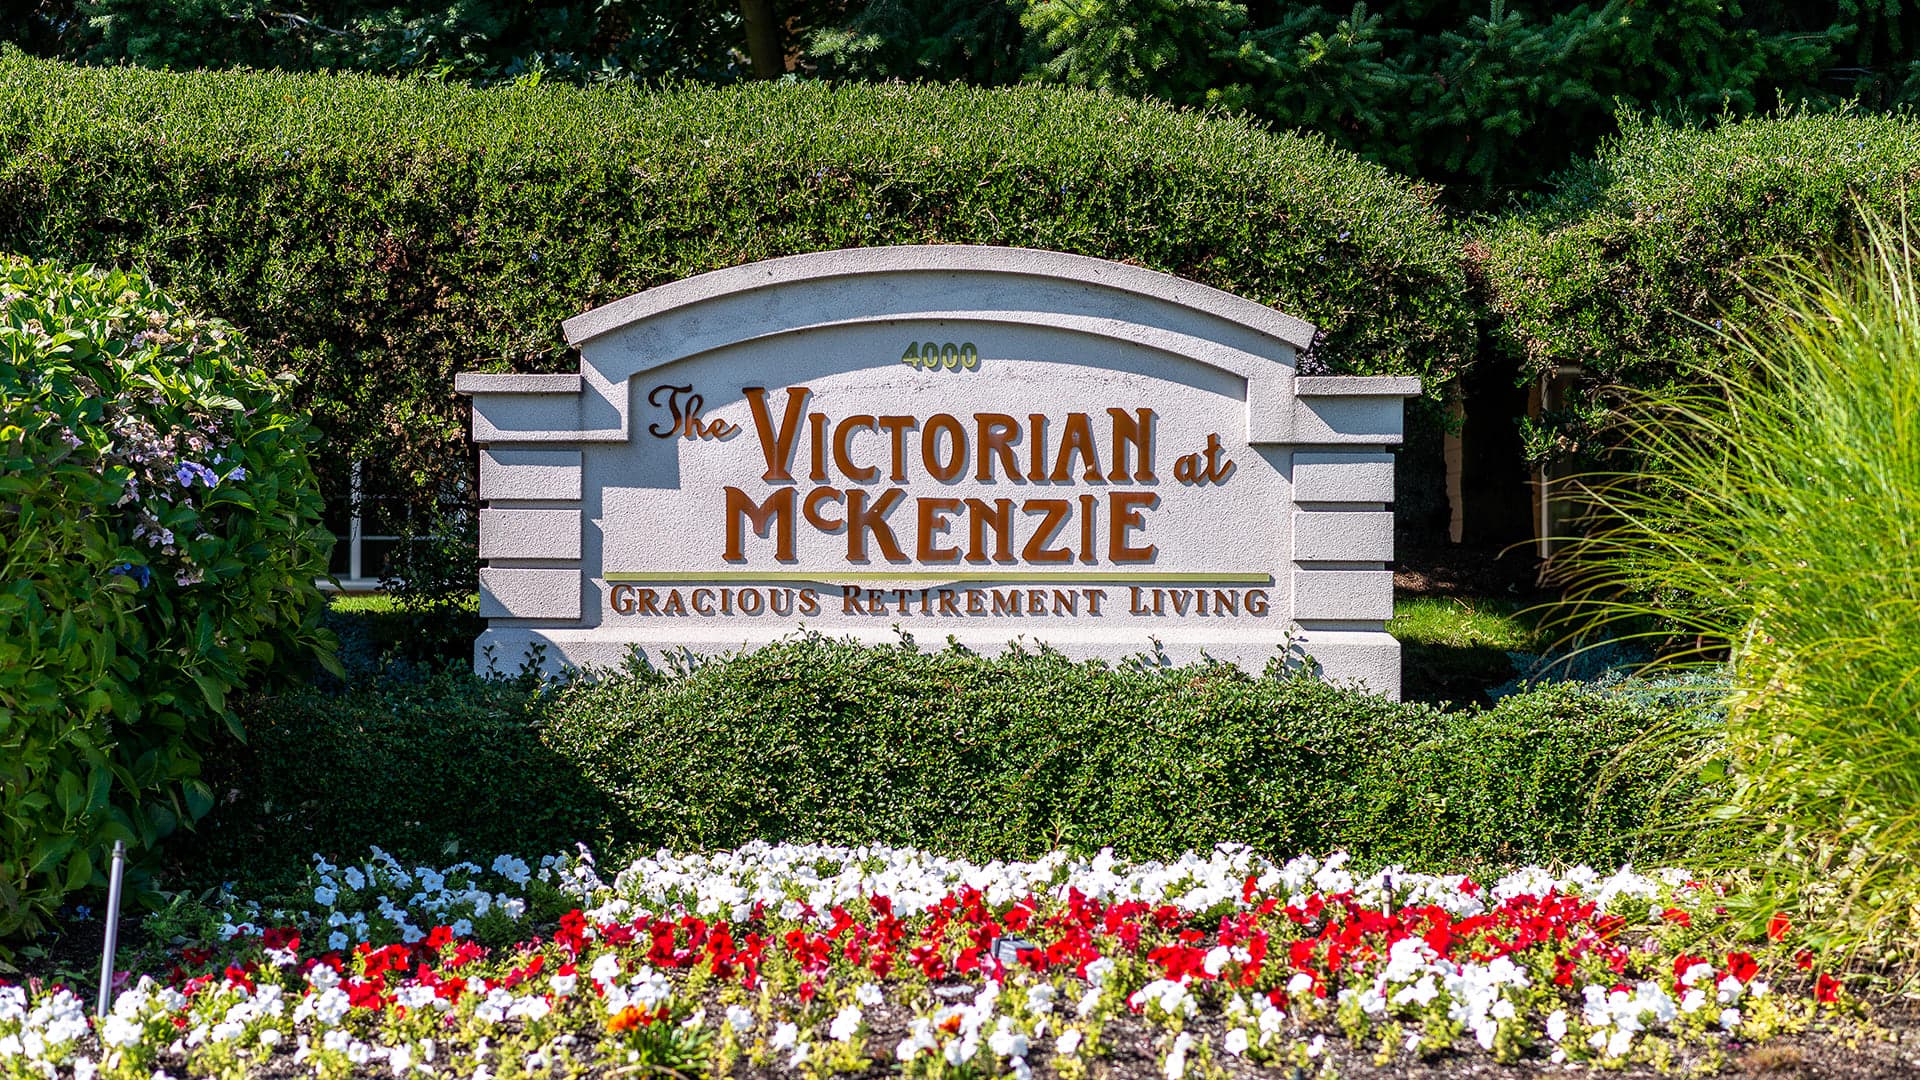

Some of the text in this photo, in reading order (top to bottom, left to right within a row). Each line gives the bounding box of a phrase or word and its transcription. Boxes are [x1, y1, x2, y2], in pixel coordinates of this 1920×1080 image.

[902, 341, 977, 368] 4000
[649, 384, 1234, 483] The VICTORIAN at
[610, 584, 1270, 615] GRACIOUS RETIREMENT LIVING
